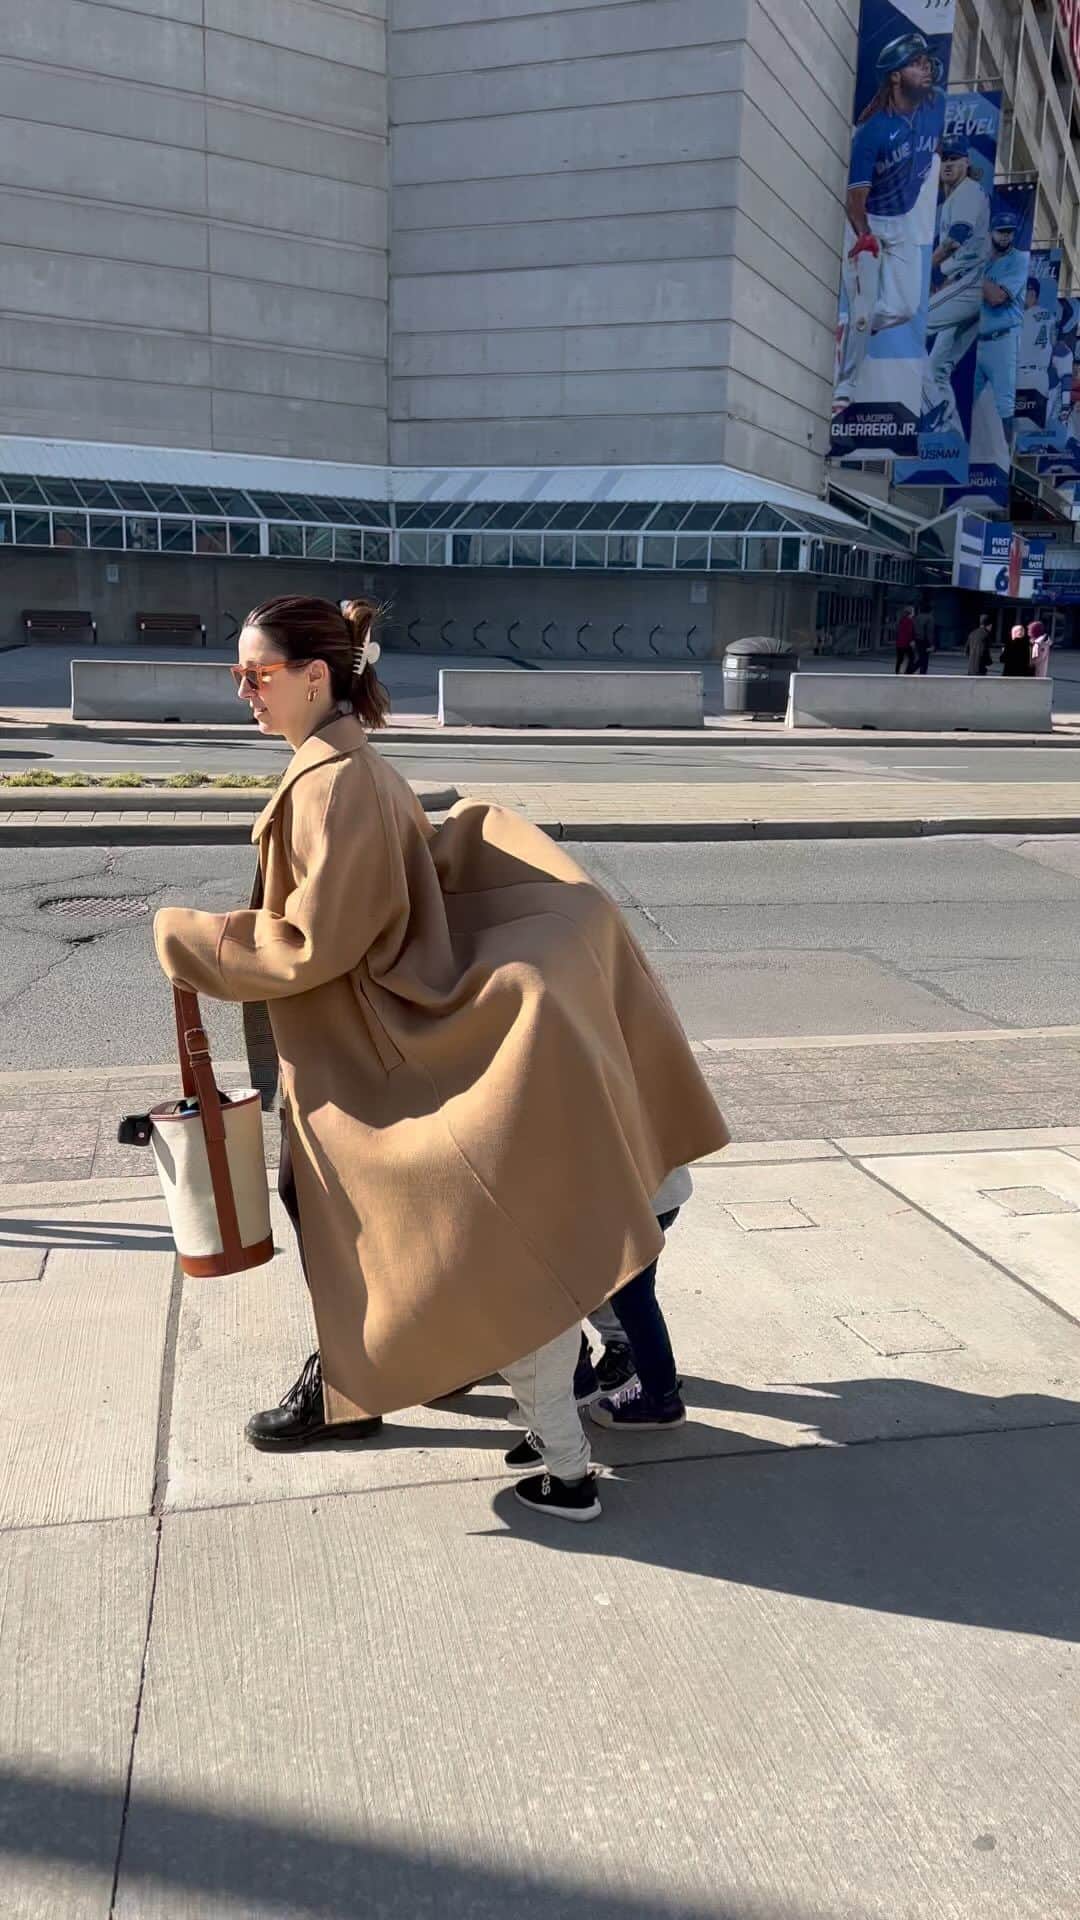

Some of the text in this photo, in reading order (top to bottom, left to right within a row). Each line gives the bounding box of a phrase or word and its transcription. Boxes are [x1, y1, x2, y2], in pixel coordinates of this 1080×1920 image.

[942, 118, 996, 137] LEVEL
[831, 422, 919, 437] GUERRERO JR.
[991, 536, 1010, 546] FIRST
[991, 546, 1009, 556] BASE
[995, 566, 1009, 592] 6
